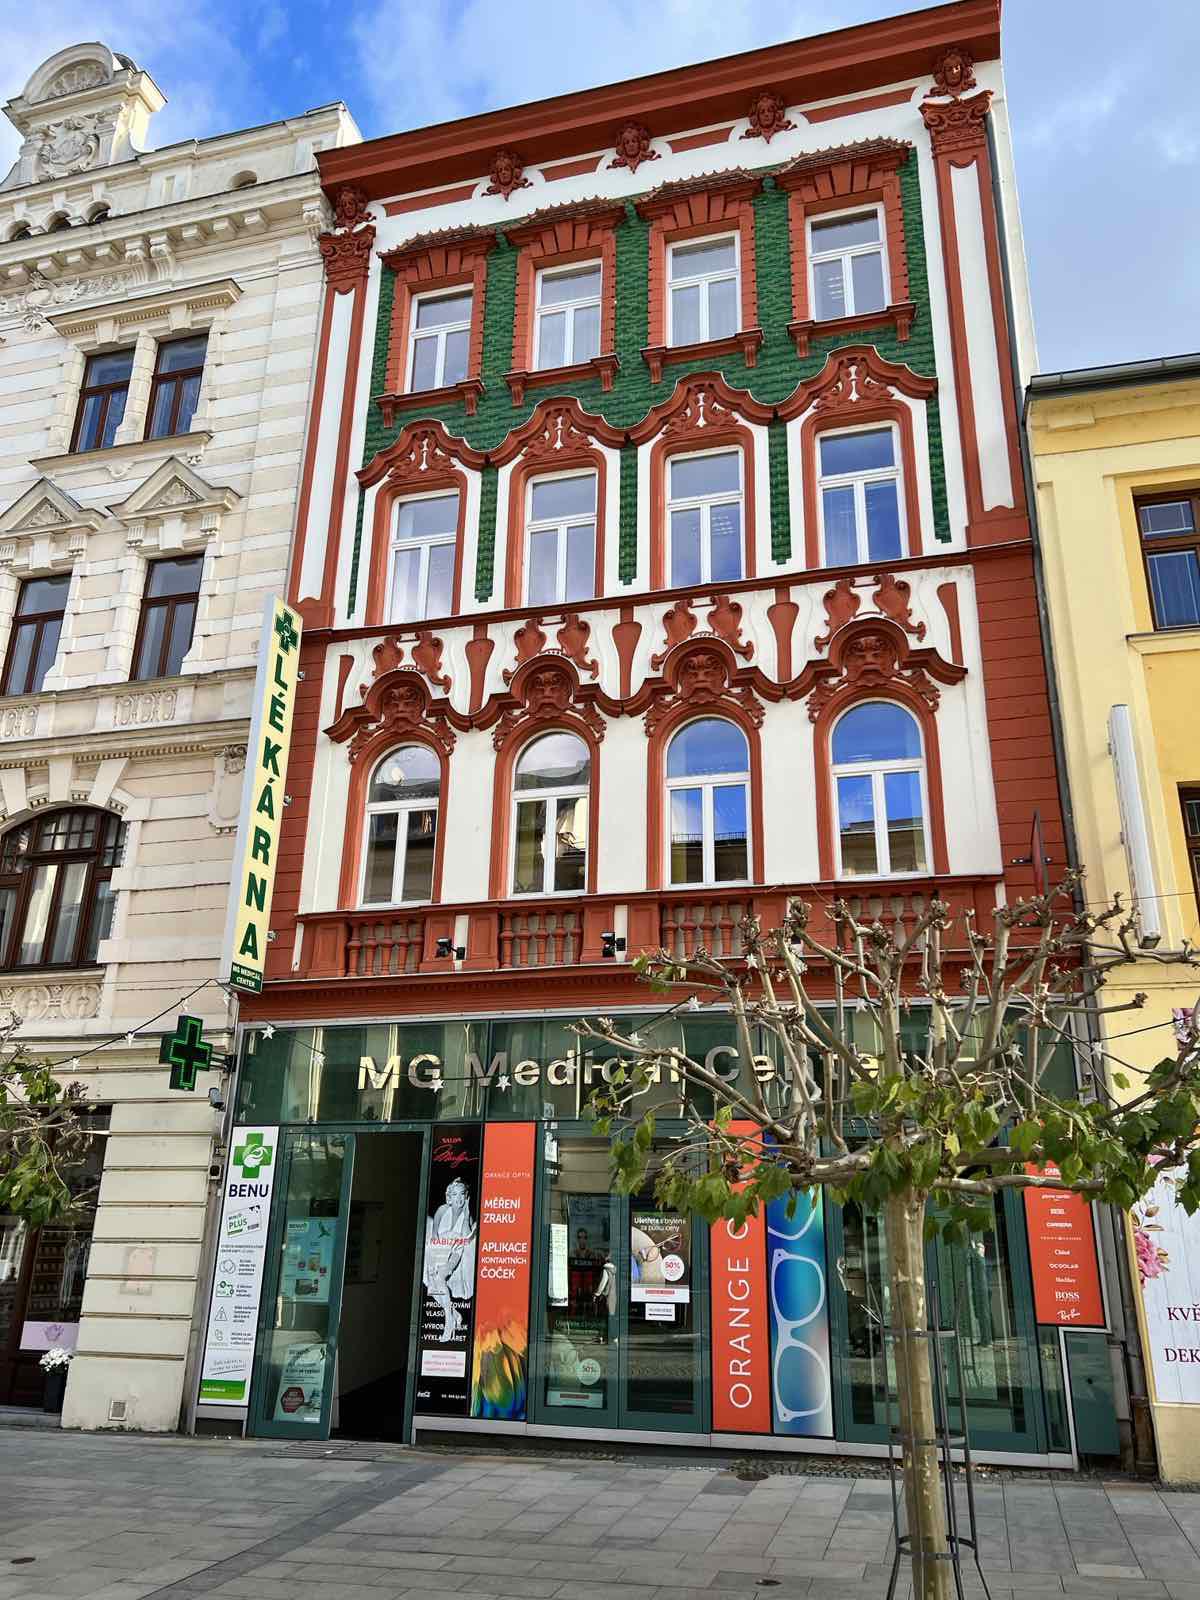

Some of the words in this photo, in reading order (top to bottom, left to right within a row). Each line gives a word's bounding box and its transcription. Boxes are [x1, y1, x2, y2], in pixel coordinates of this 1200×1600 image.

[239, 653, 289, 961] LÉKÁRNA
[357, 1053, 443, 1091] MG
[228, 1184, 269, 1198] BENU
[484, 1197, 520, 1209] MĚŘENÍ
[228, 1218, 248, 1230] PLUS
[483, 1213, 516, 1223] ZRAKU
[481, 1242, 527, 1253] APLIKACE
[481, 1256, 527, 1265] KONTAKTNÍCH
[480, 1266, 516, 1279] ČOČEK
[1056, 1291, 1080, 1299] BOSS
[1167, 1303, 1200, 1321] KVĚ
[728, 1256, 752, 1409] ORANGE
[1165, 1348, 1200, 1363] DEK
